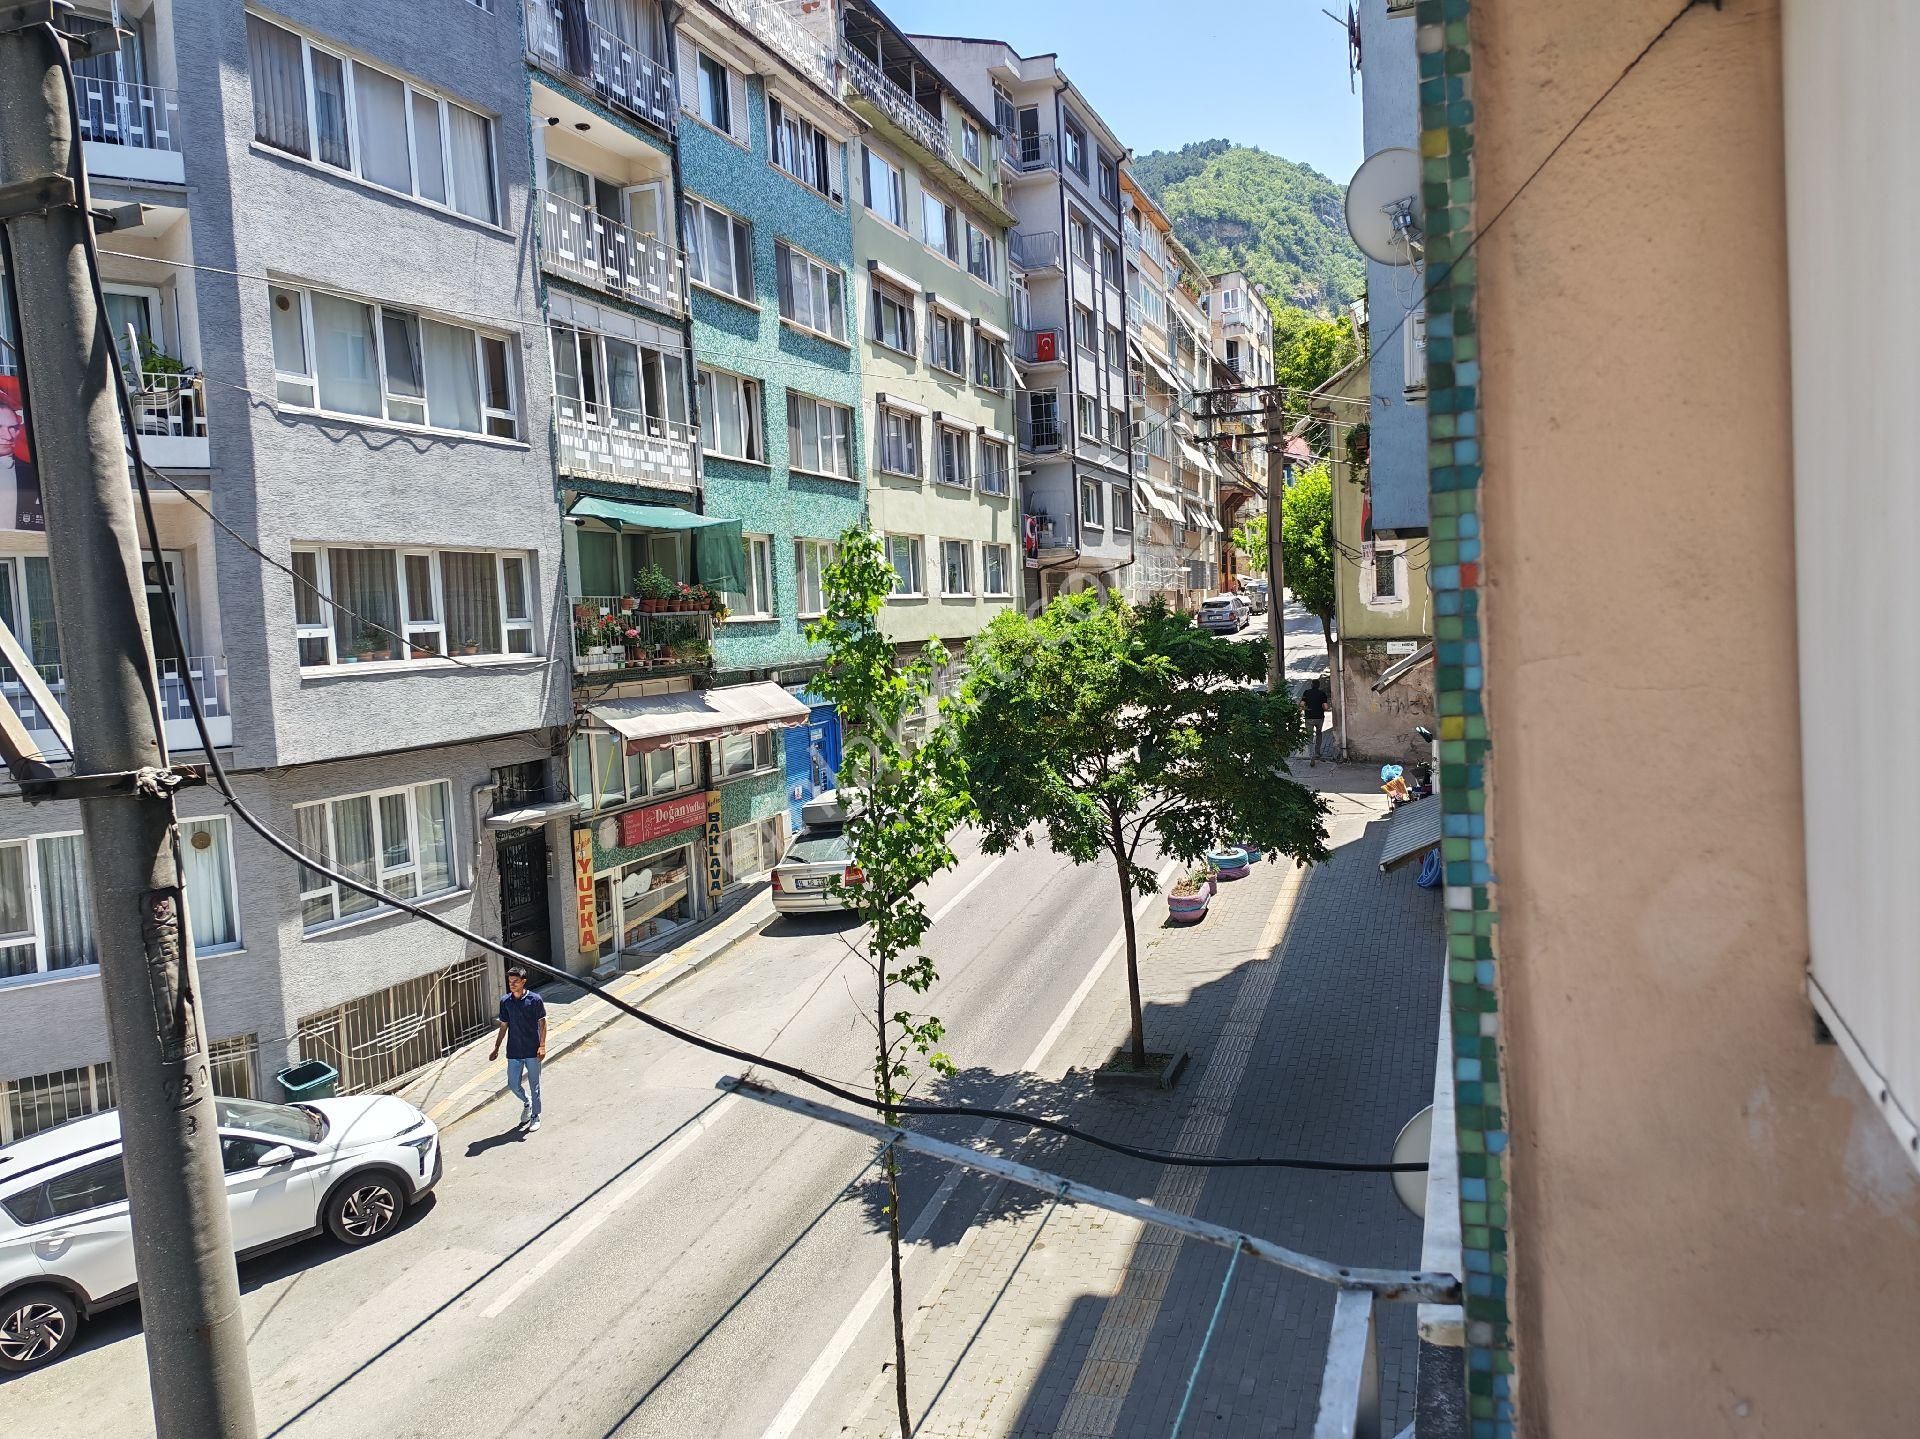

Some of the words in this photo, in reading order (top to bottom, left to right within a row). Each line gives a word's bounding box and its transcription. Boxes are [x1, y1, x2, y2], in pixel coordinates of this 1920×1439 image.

[655, 804, 685, 823] Doğan
[685, 801, 706, 815] Yufka
[708, 812, 721, 890] BAKLAVA
[578, 859, 595, 946] YUFKA
